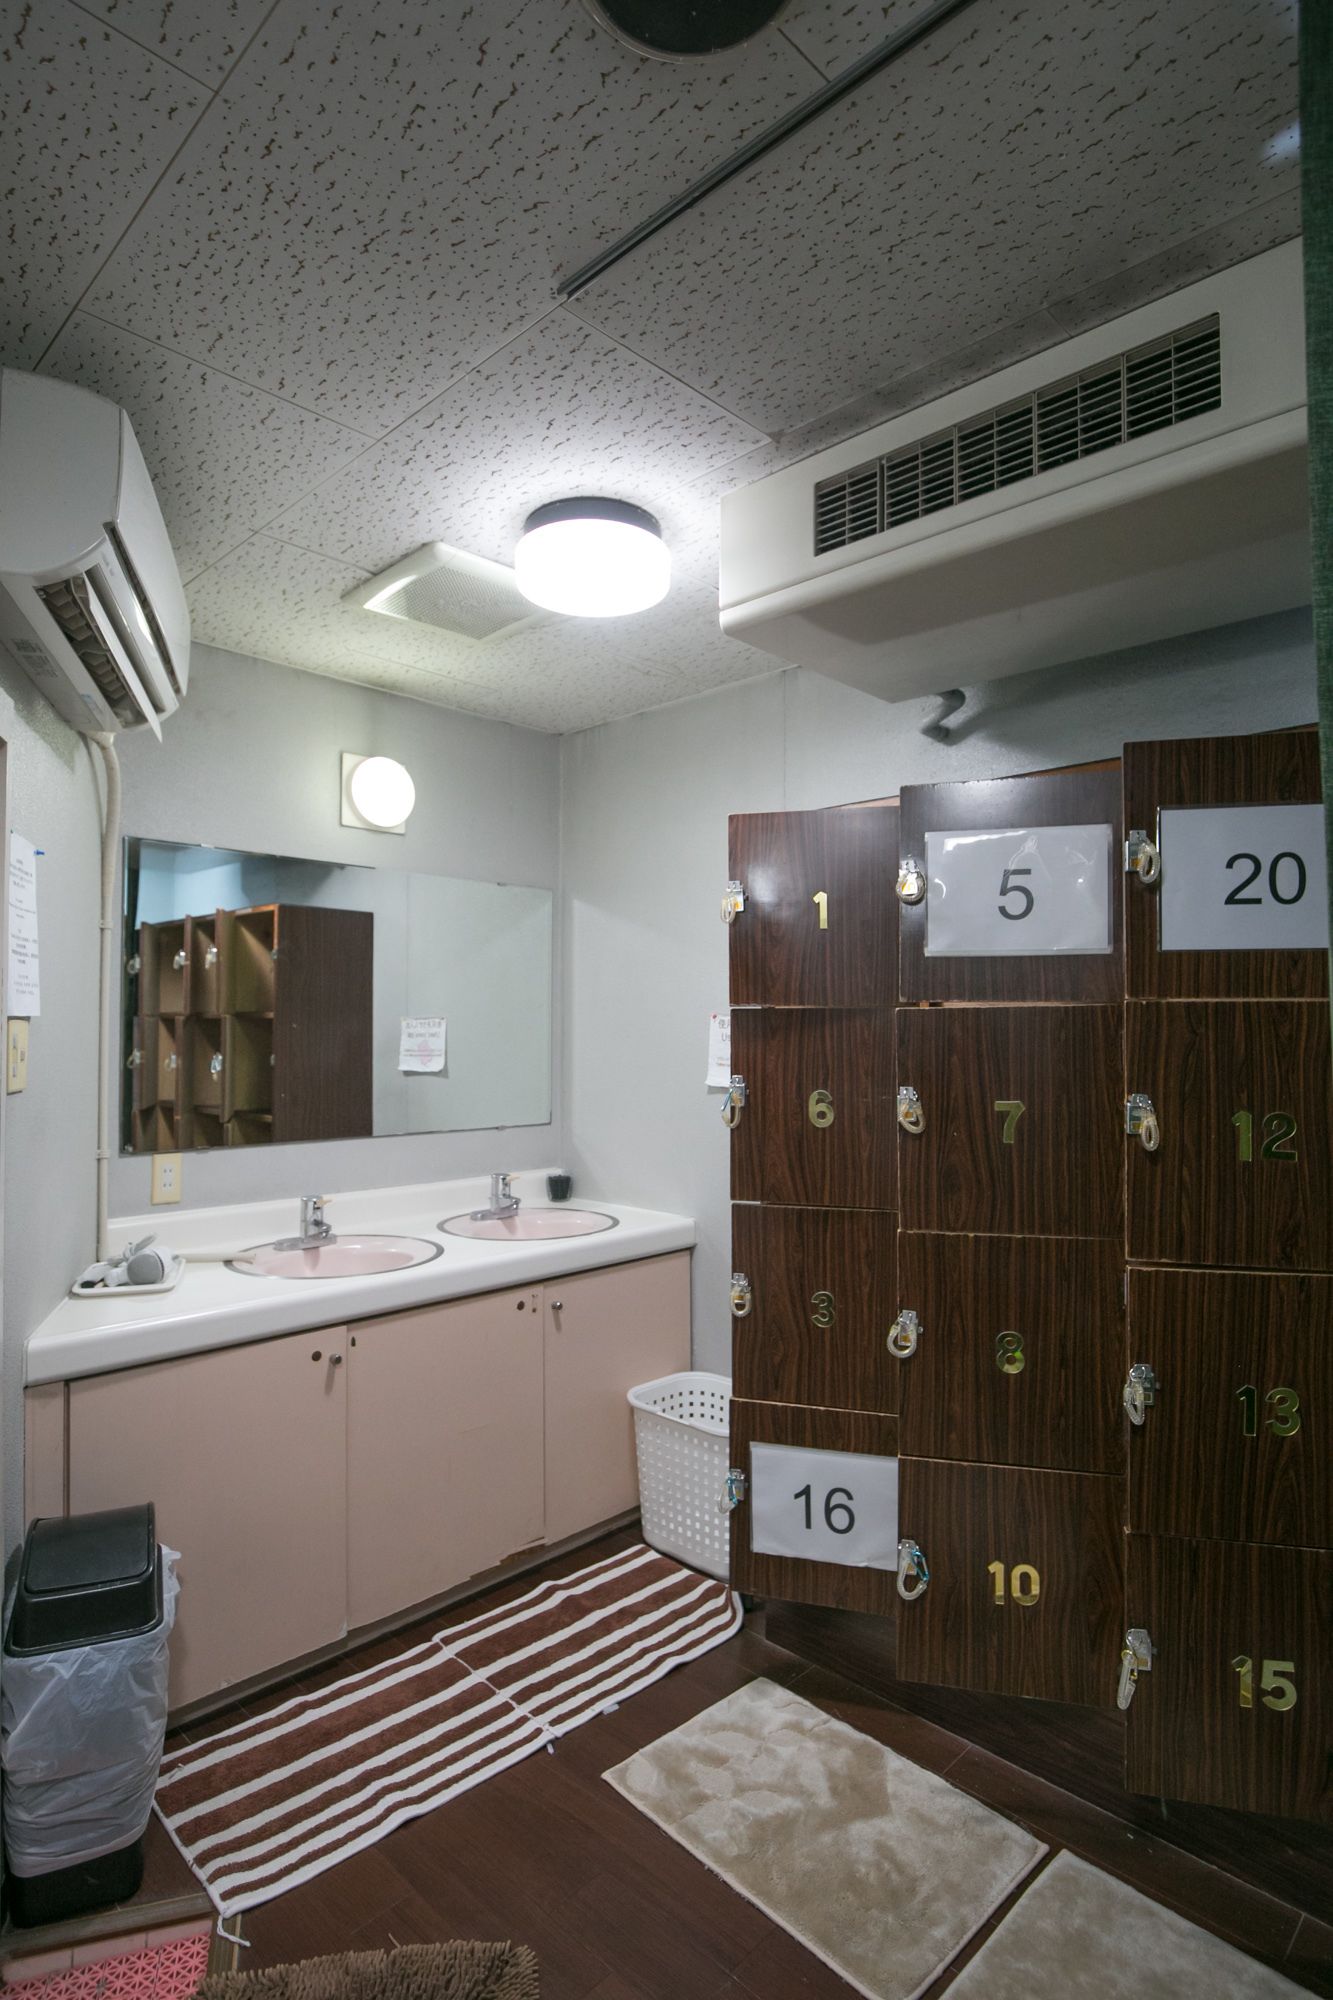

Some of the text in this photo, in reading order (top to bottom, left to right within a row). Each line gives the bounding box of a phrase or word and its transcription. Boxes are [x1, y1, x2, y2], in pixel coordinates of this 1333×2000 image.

[997, 868, 1035, 921] 5
[1223, 851, 1308, 906] 20
[812, 890, 829, 930] 1
[808, 1089, 835, 1128] 6
[994, 1100, 1026, 1144] 7
[1231, 1110, 1299, 1162] 12
[811, 1290, 836, 1328] 3
[995, 1330, 1026, 1375] 8
[1235, 1385, 1302, 1437] 13
[792, 1485, 856, 1535] 16
[987, 1560, 1041, 1607] 10
[1231, 1655, 1298, 1712] 15
